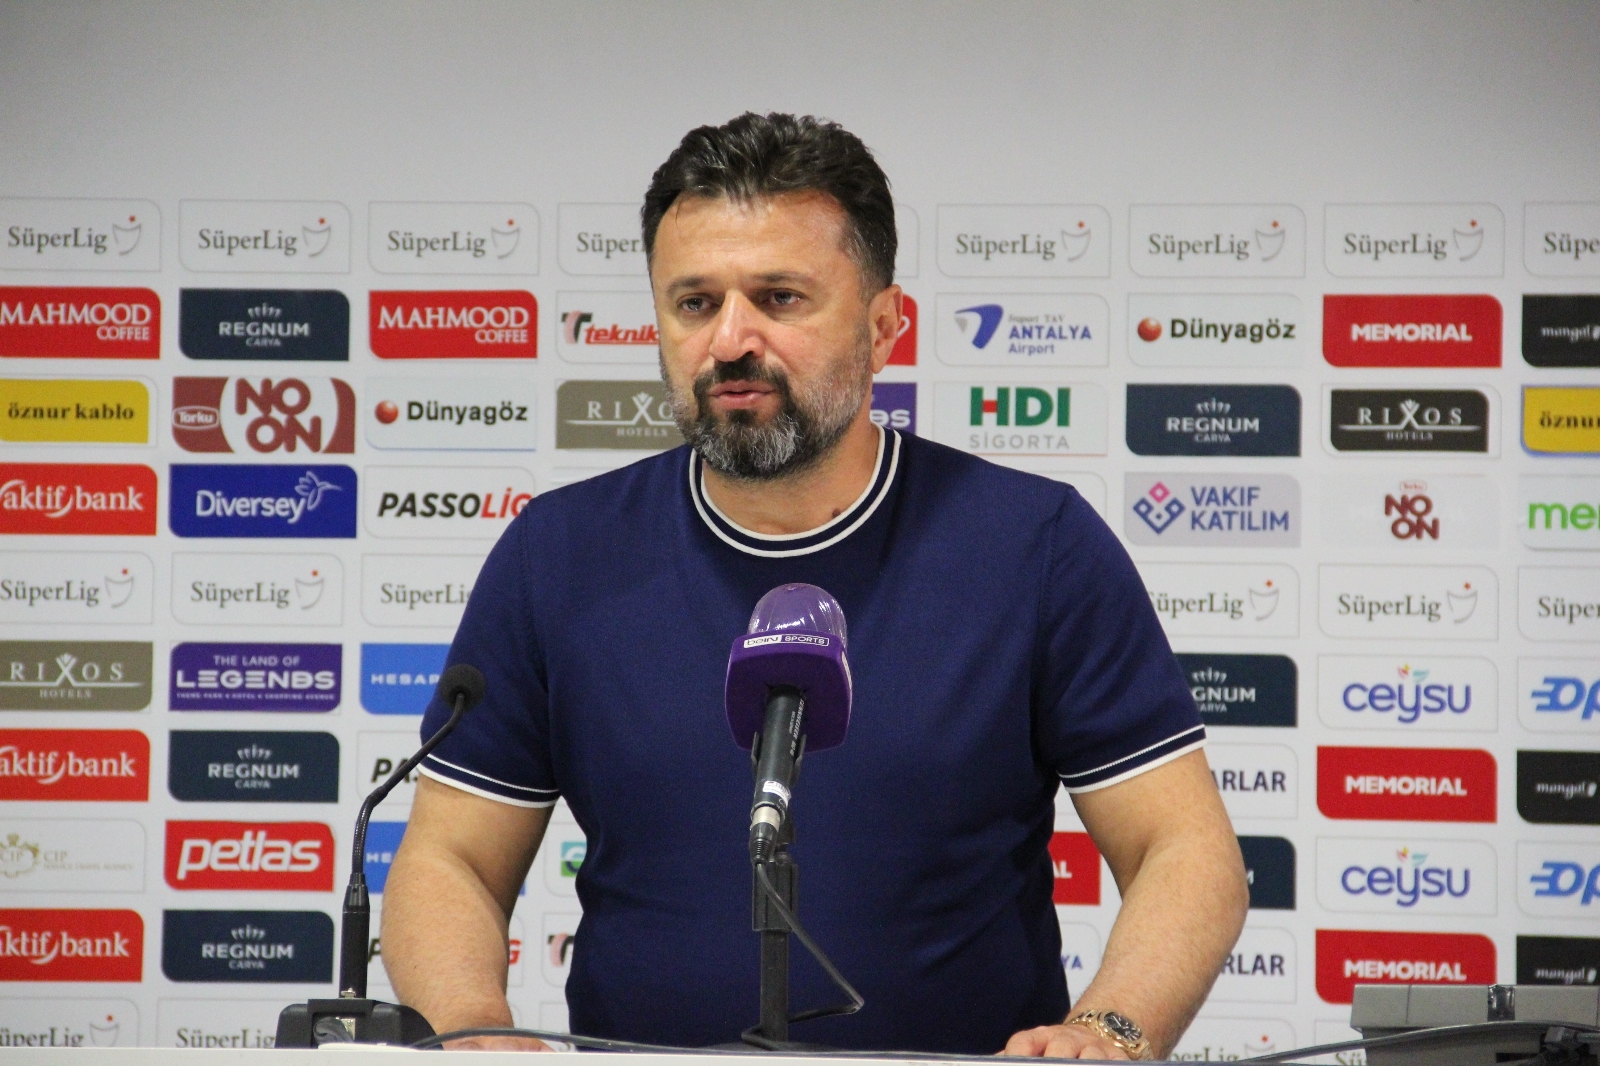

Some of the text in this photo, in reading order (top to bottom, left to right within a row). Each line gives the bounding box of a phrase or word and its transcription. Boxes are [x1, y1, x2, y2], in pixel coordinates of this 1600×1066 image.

[7, 226, 107, 254] SüperLig
[198, 228, 297, 257] SüperLig
[387, 230, 486, 258] SüperLig
[955, 232, 1056, 260] SüperLig
[1148, 232, 1250, 260] SüperLig
[1344, 232, 1447, 260] SüperLig
[0, 301, 152, 325] MAHMOOD
[378, 305, 529, 329] MAHMOOD
[96, 326, 150, 341] COFFEE
[218, 321, 310, 337] REGNUM
[475, 328, 528, 344] COFFEE
[1008, 324, 1092, 340] ANTALYA
[1170, 318, 1295, 343] Dünyagöz
[1351, 323, 1473, 342] MEMORIAL
[1008, 342, 1055, 356] Airport
[8, 401, 135, 421] öznur kablo
[179, 411, 214, 424] Torku
[407, 401, 528, 426] Dünyagöz
[587, 392, 673, 425] RIXO
[970, 387, 1071, 427] HDI
[1358, 399, 1463, 428] RIXOS
[616, 427, 668, 437] HOTELS
[1166, 417, 1260, 433] REGNUM
[1386, 432, 1433, 441] HOTELS
[2, 484, 143, 514] aktif bank
[195, 489, 305, 524] Diversey
[1191, 486, 1260, 507] VAKIF
[1191, 511, 1289, 531] KATILIM
[0, 579, 99, 607] SüperLig
[190, 581, 289, 608] SüperLig
[380, 583, 471, 610] SüperLi
[1338, 594, 1441, 622] SüperLig
[784, 635, 825, 645] SPORTS
[10, 653, 124, 687] RIXOS
[213, 655, 300, 667] THE LAND OF
[176, 669, 335, 690] LEGENDS
[1191, 686, 1256, 702] GNUM
[1343, 682, 1472, 724] ceysu
[67, 751, 136, 777] bank
[208, 763, 299, 779] REGNUM
[1345, 775, 1468, 797] MEMORIAL
[176, 830, 321, 880] petlas
[1341, 865, 1470, 907] ceysu
[61, 930, 129, 957] bank
[202, 943, 294, 959] REGNUM
[1344, 960, 1467, 982] MEMORIAL
